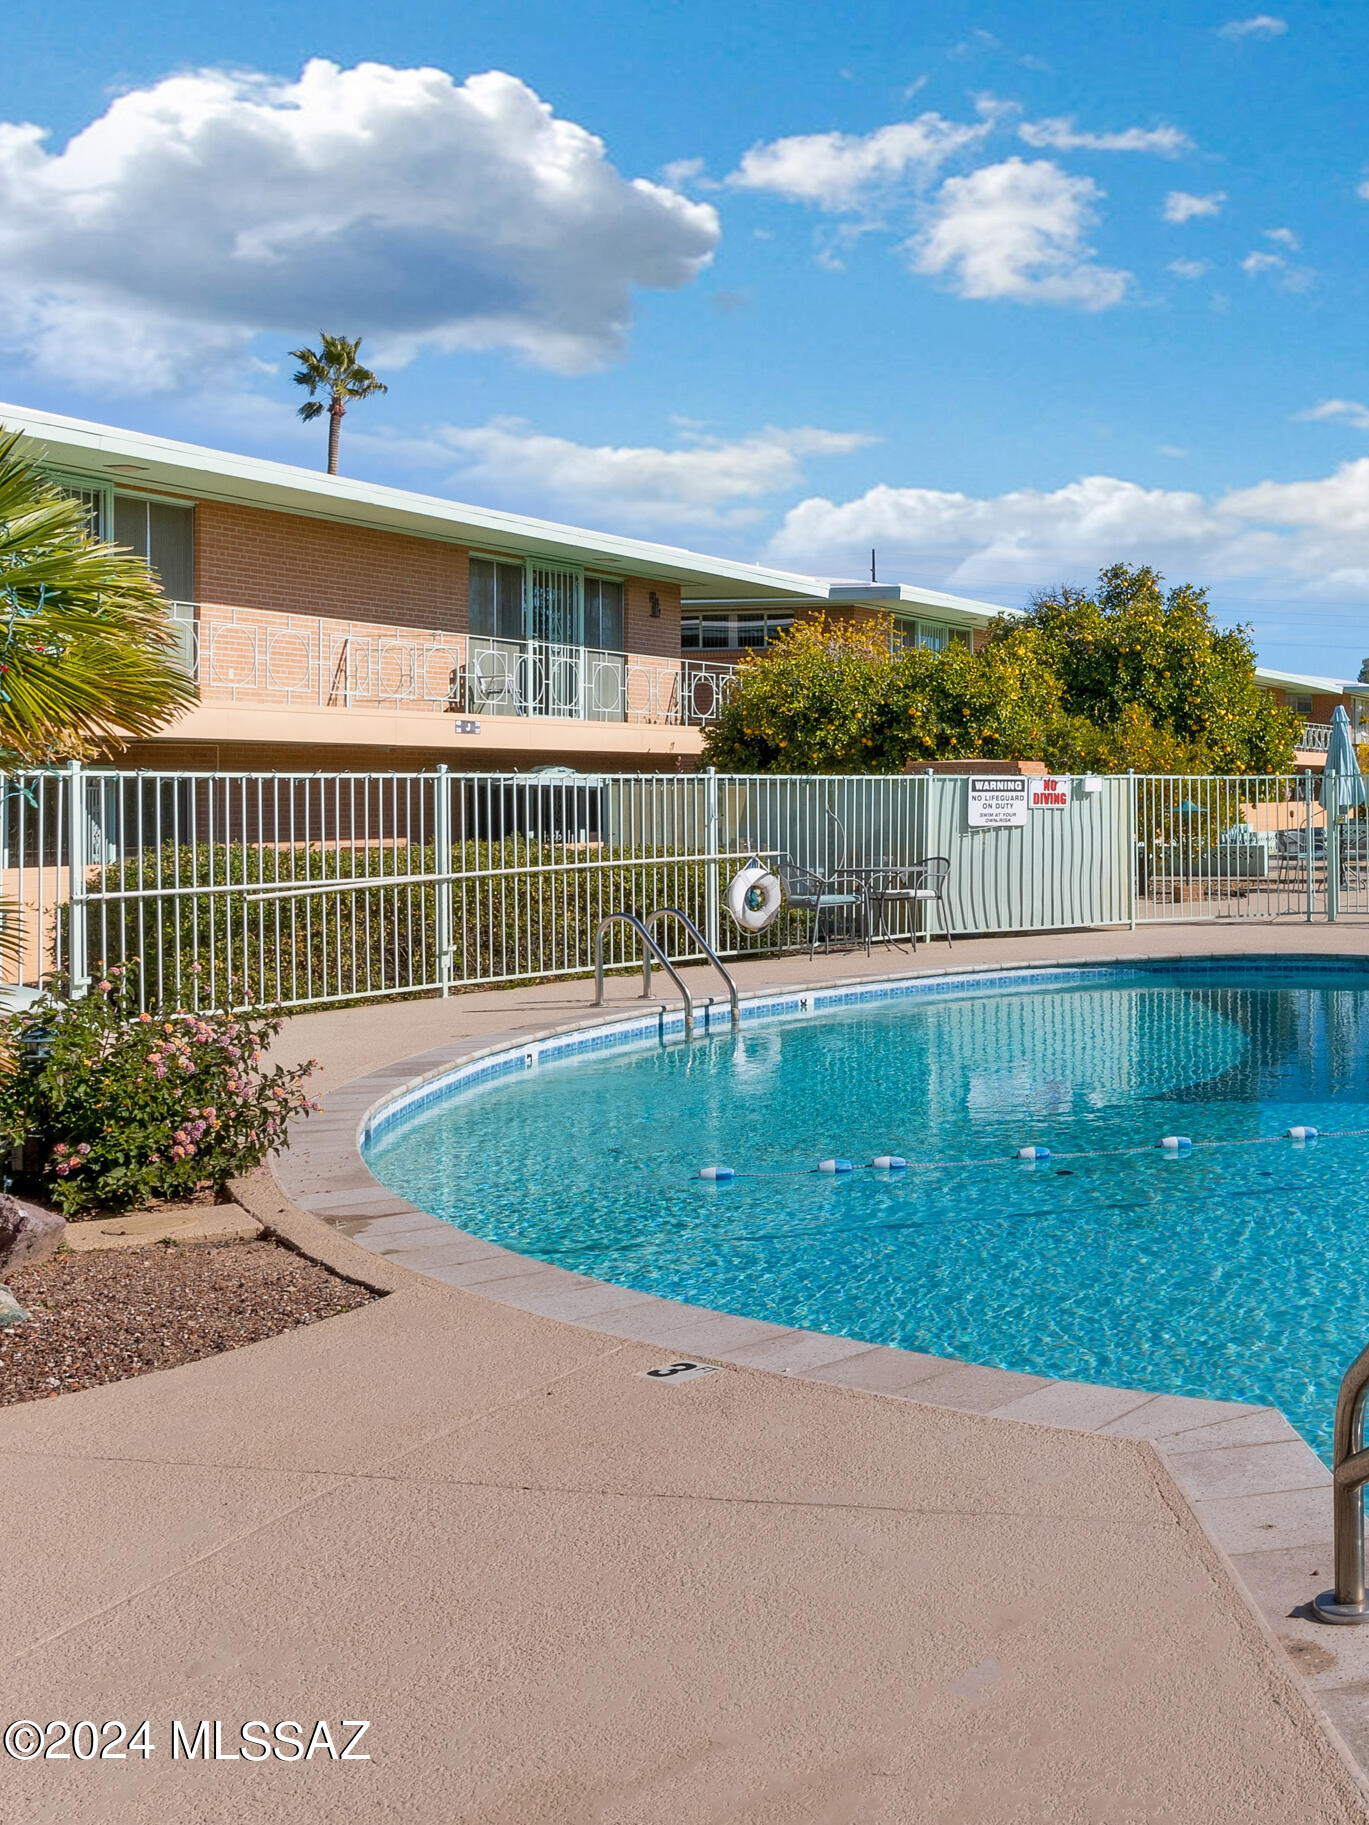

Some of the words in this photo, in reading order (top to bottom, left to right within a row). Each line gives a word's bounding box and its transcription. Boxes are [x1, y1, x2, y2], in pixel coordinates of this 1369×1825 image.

[975, 781, 1022, 791] WARNING
[1043, 779, 1057, 791] NO
[1033, 793, 1067, 805] DIVING
[646, 1362, 697, 1377] 3
